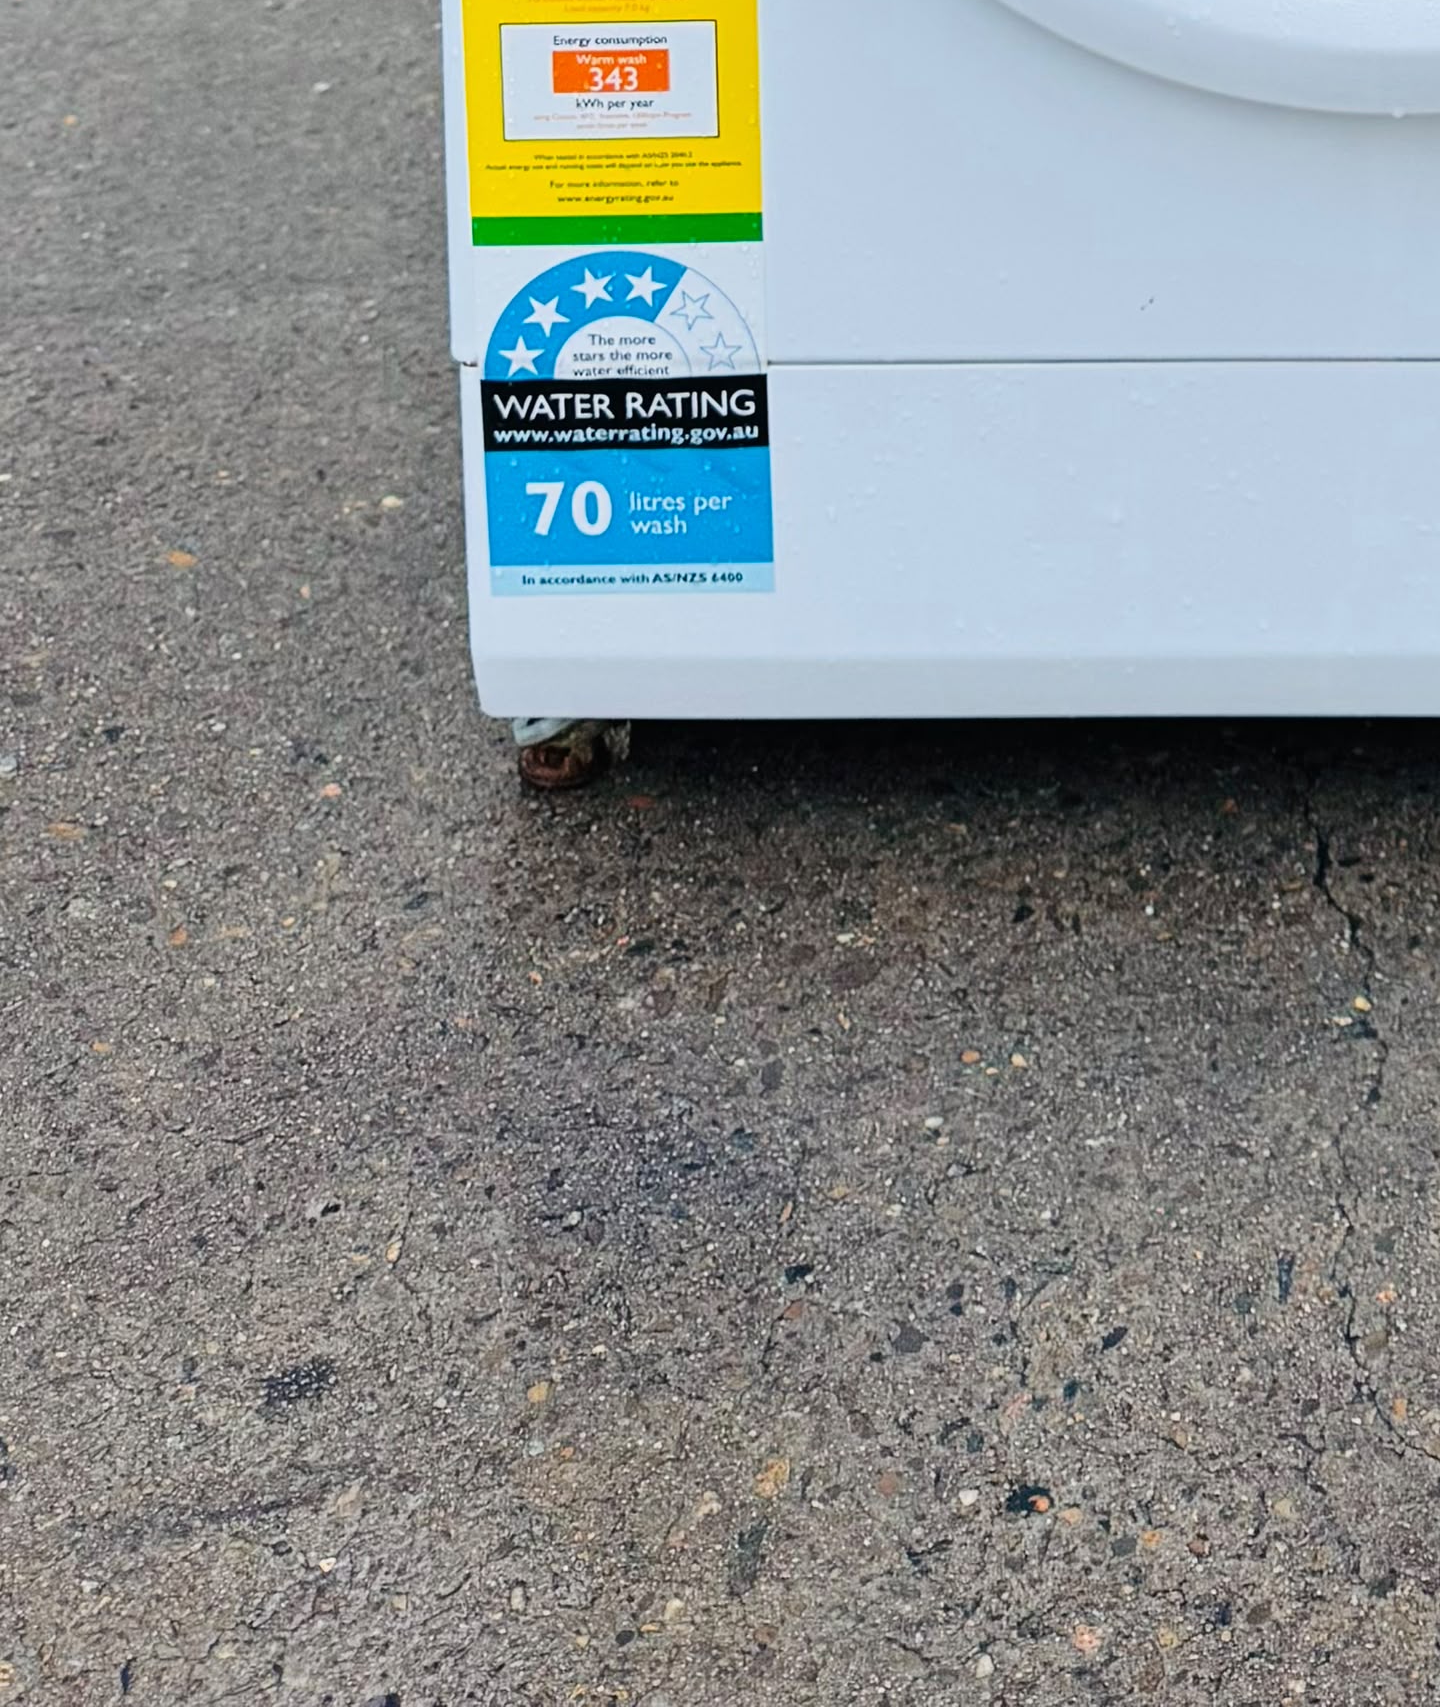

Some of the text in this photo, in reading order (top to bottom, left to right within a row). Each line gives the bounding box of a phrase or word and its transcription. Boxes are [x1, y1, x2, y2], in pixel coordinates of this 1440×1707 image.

[553, 35, 668, 48] Energy consumption
[576, 53, 647, 65] Warm wash
[589, 67, 639, 92] 343
[576, 98, 655, 111] kWh per year
[588, 334, 656, 345] The more
[573, 350, 673, 362] stars the more
[573, 364, 669, 376] water efficient
[493, 389, 755, 421] WATER RATING
[493, 424, 759, 445] www.waterrating.gov.au
[525, 480, 732, 536] 70 litres per
[630, 515, 687, 535] wash
[522, 571, 743, 585] In accordance with AS/NZS 6400
